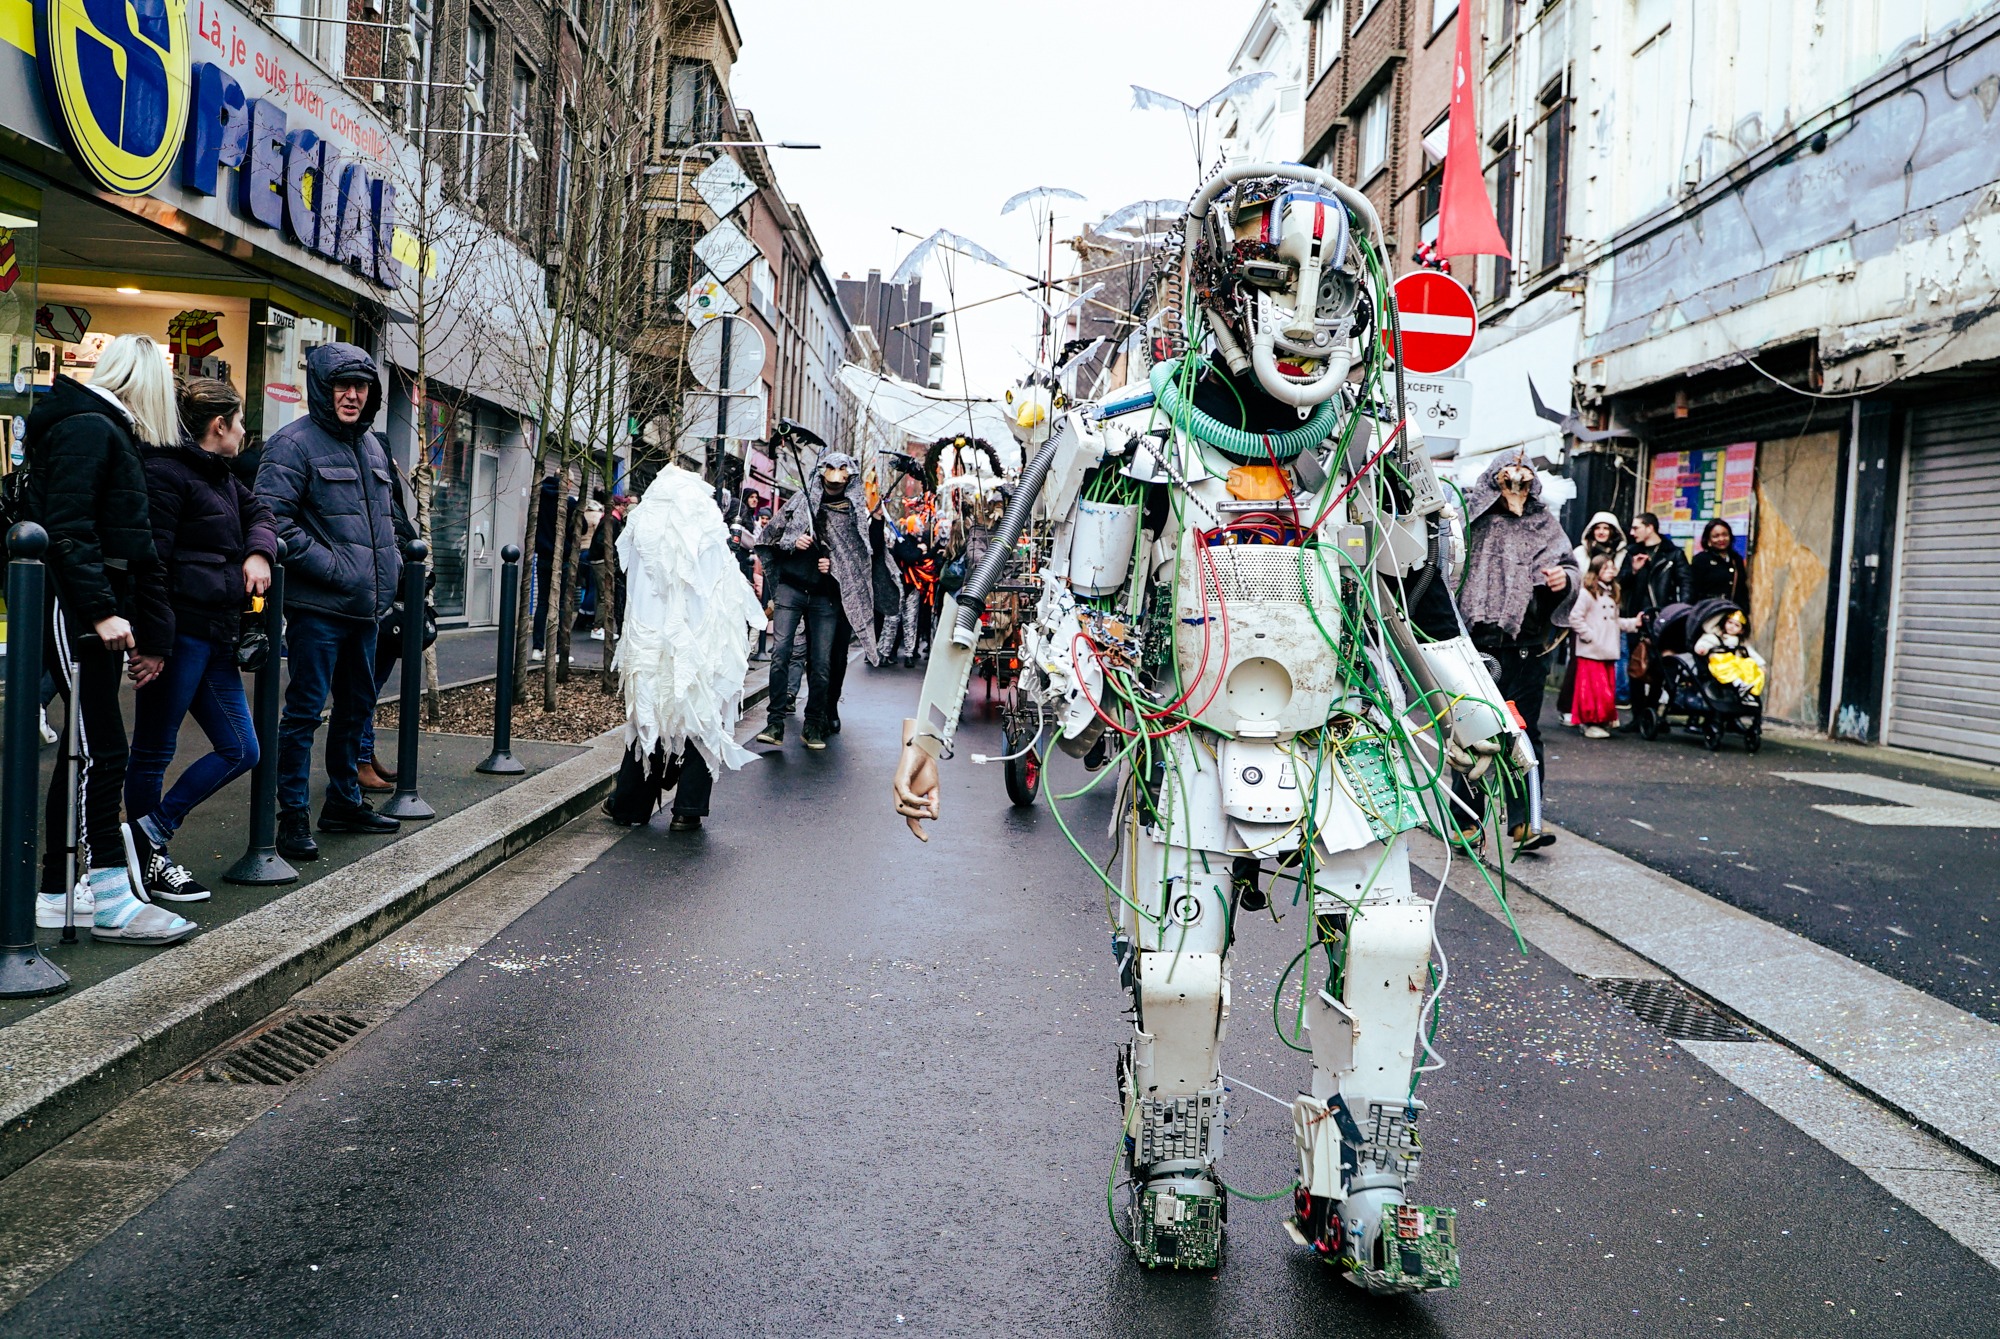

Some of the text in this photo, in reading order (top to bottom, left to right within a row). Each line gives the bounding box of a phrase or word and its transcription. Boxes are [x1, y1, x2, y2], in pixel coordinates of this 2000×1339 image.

[198, 2, 226, 58] Là,
[229, 25, 247, 68] je
[255, 52, 287, 94] suis
[294, 72, 326, 121] bien
[330, 107, 384, 161] conseillé
[272, 311, 296, 330] TOUTES
[1438, 420, 1445, 429] P
